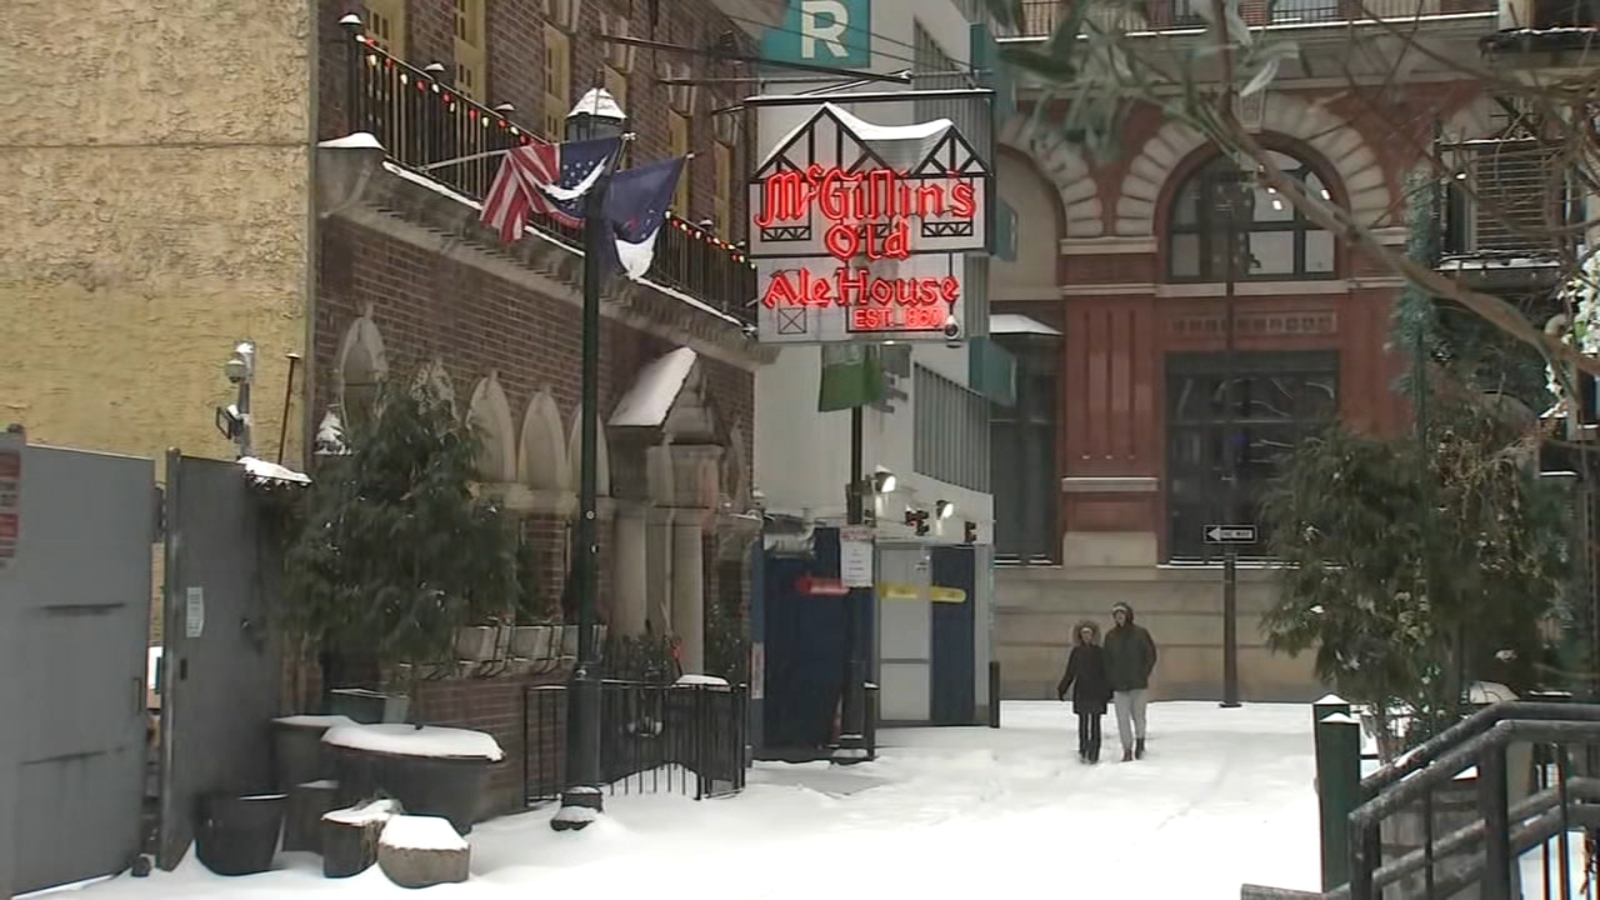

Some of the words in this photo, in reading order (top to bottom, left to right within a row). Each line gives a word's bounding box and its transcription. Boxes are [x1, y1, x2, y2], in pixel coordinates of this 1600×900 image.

[801, 0, 849, 59] R
[825, 217, 909, 260] Old
[764, 267, 832, 309] Ale
[834, 268, 960, 307] House
[854, 308, 894, 328] EST.
